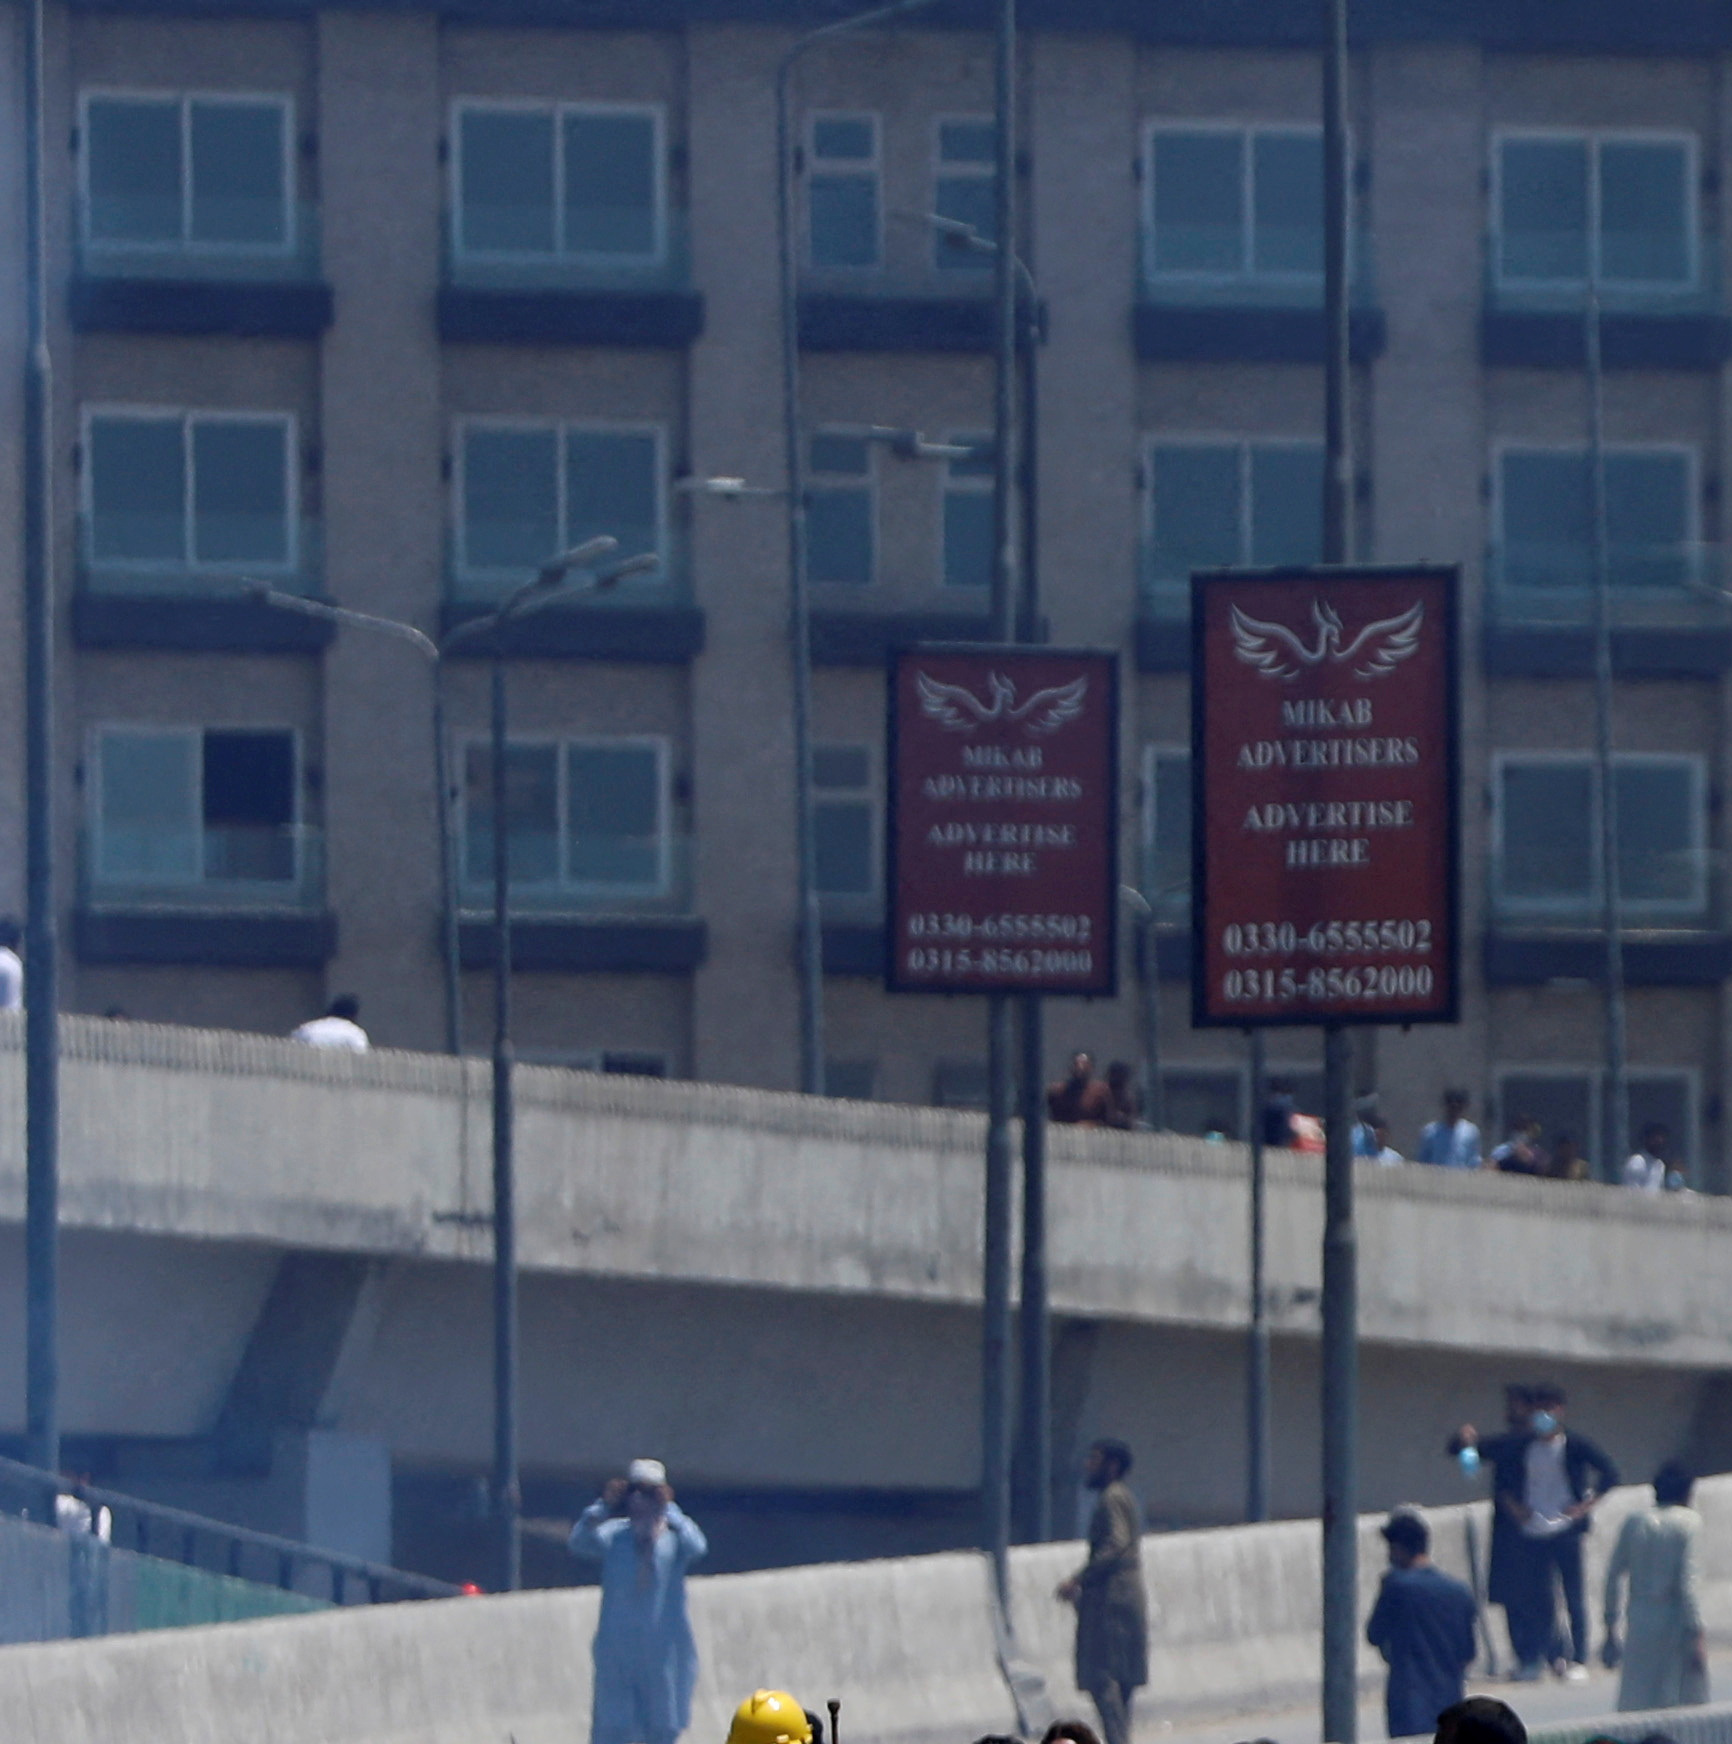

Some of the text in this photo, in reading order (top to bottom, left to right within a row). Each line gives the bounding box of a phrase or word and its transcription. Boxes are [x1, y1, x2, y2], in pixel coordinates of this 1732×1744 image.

[1282, 698, 1373, 726] MIKAB
[1237, 737, 1419, 767] ADVERTISERS
[922, 774, 1083, 798] ADVERTISERS
[1244, 801, 1414, 830] ADVERTISE
[927, 822, 1076, 845] ADVERTISE
[964, 851, 1036, 874] HERE
[1286, 838, 1370, 866] HERE
[1223, 920, 1432, 953] 0330-6555502
[1223, 966, 1433, 1000] 0315-8562000
